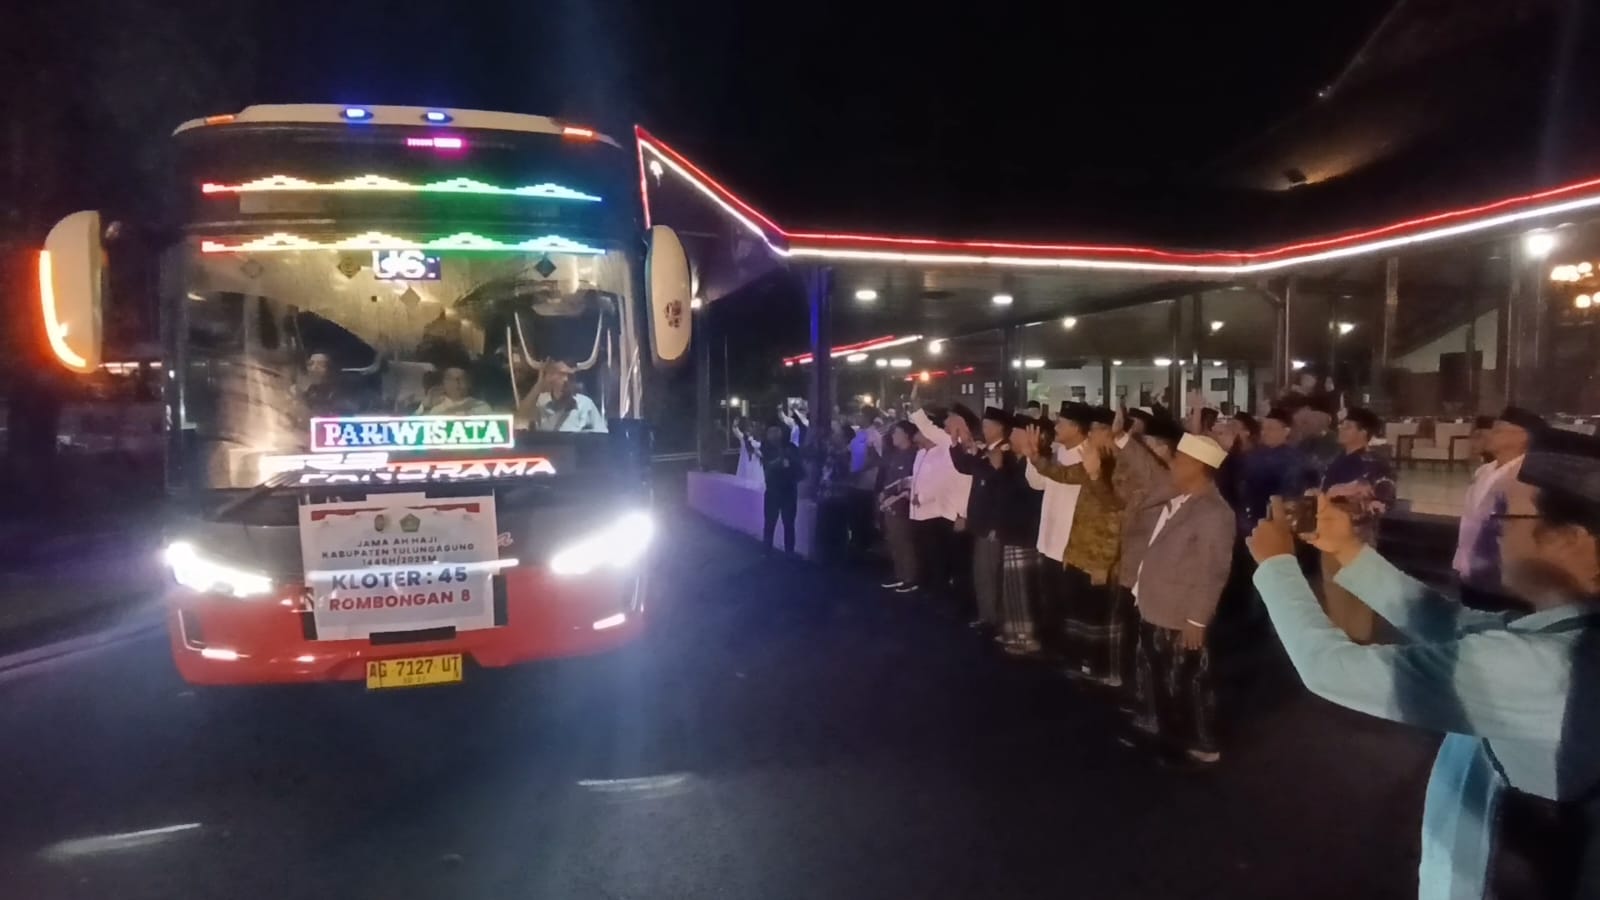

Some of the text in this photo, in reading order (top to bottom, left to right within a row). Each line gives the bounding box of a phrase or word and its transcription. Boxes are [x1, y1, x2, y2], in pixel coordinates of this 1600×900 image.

[323, 420, 506, 447] PARIWISATA
[321, 543, 475, 559] KABUPATEN TULUNGAGUNG
[410, 536, 438, 545] HAJI
[331, 570, 422, 590] KLOTER
[438, 567, 468, 584] 45
[329, 589, 471, 611] ROMBONGAN 8
[369, 656, 460, 678] AG 7127 UT
